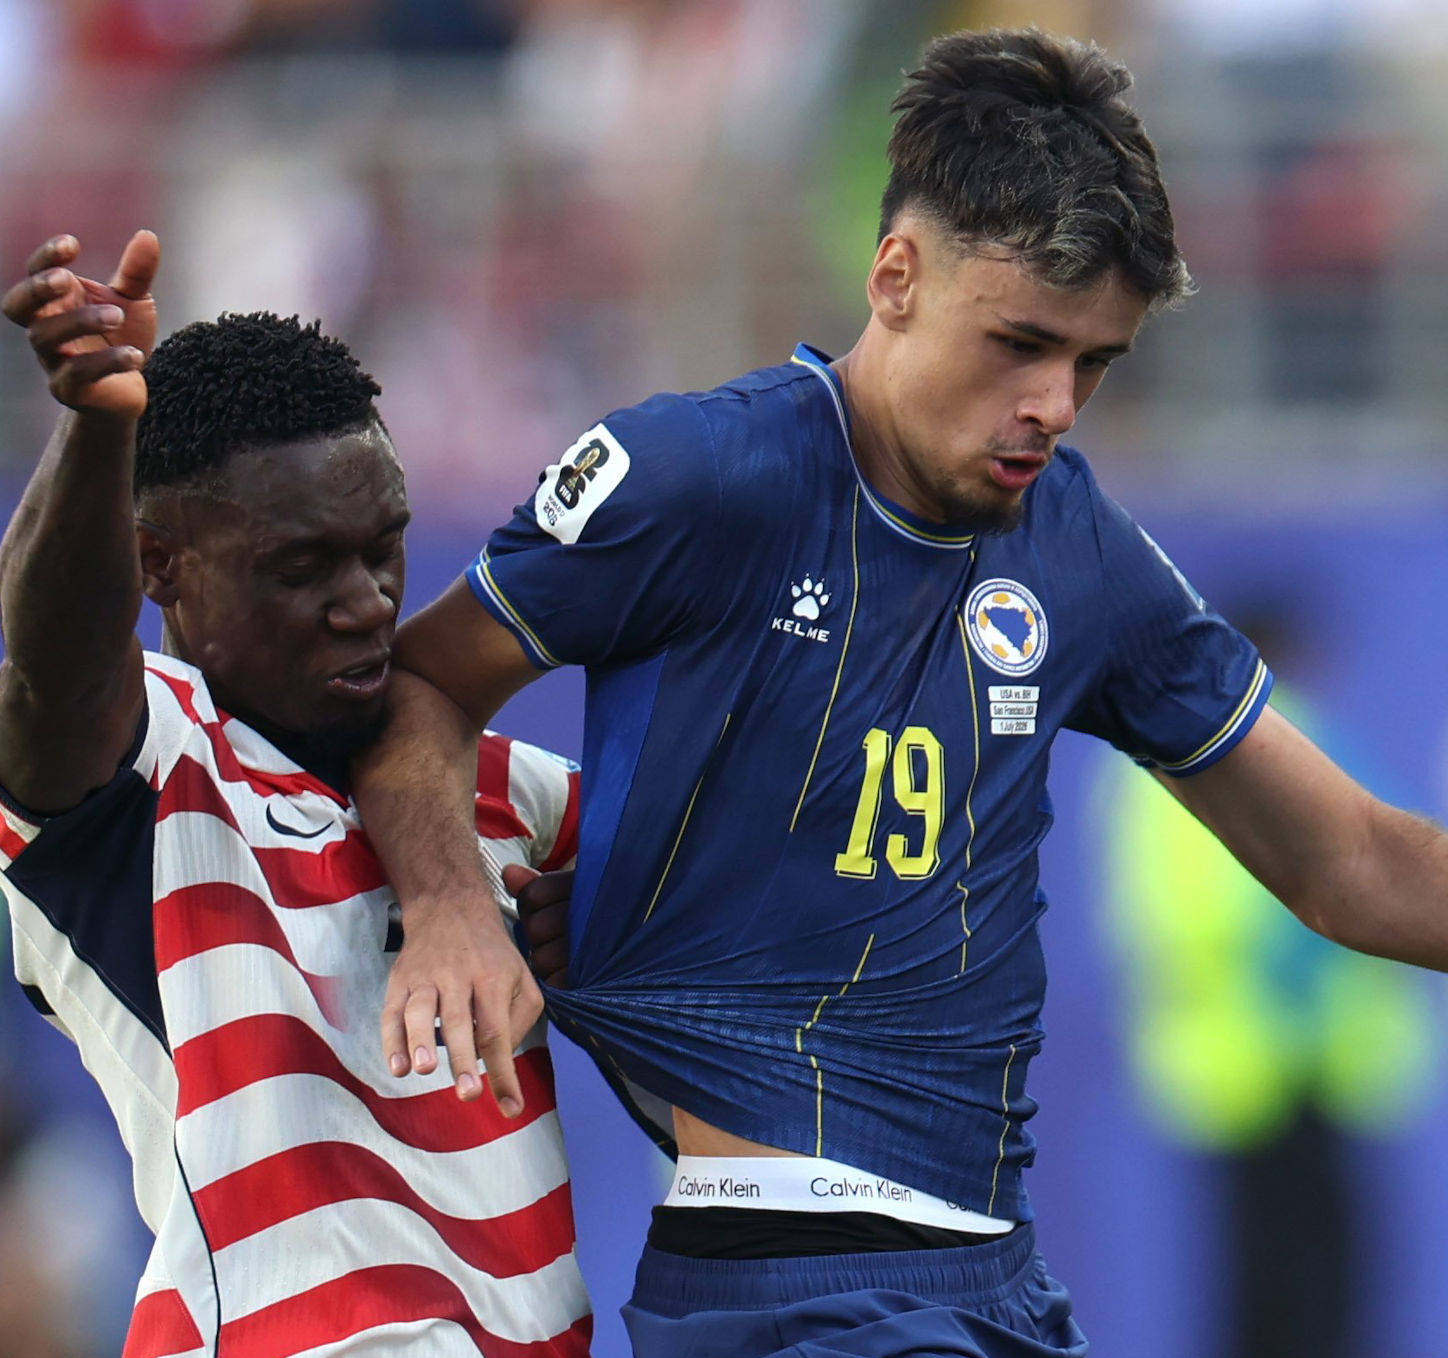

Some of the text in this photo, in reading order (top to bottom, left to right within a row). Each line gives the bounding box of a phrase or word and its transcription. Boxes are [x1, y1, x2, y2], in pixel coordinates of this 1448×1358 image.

[771, 617, 831, 643] KELME
[1000, 689, 1013, 699] USA
[834, 726, 946, 880] 19
[678, 1176, 761, 1198] Calvin Klein
[810, 1177, 913, 1203] Calvin Klein
